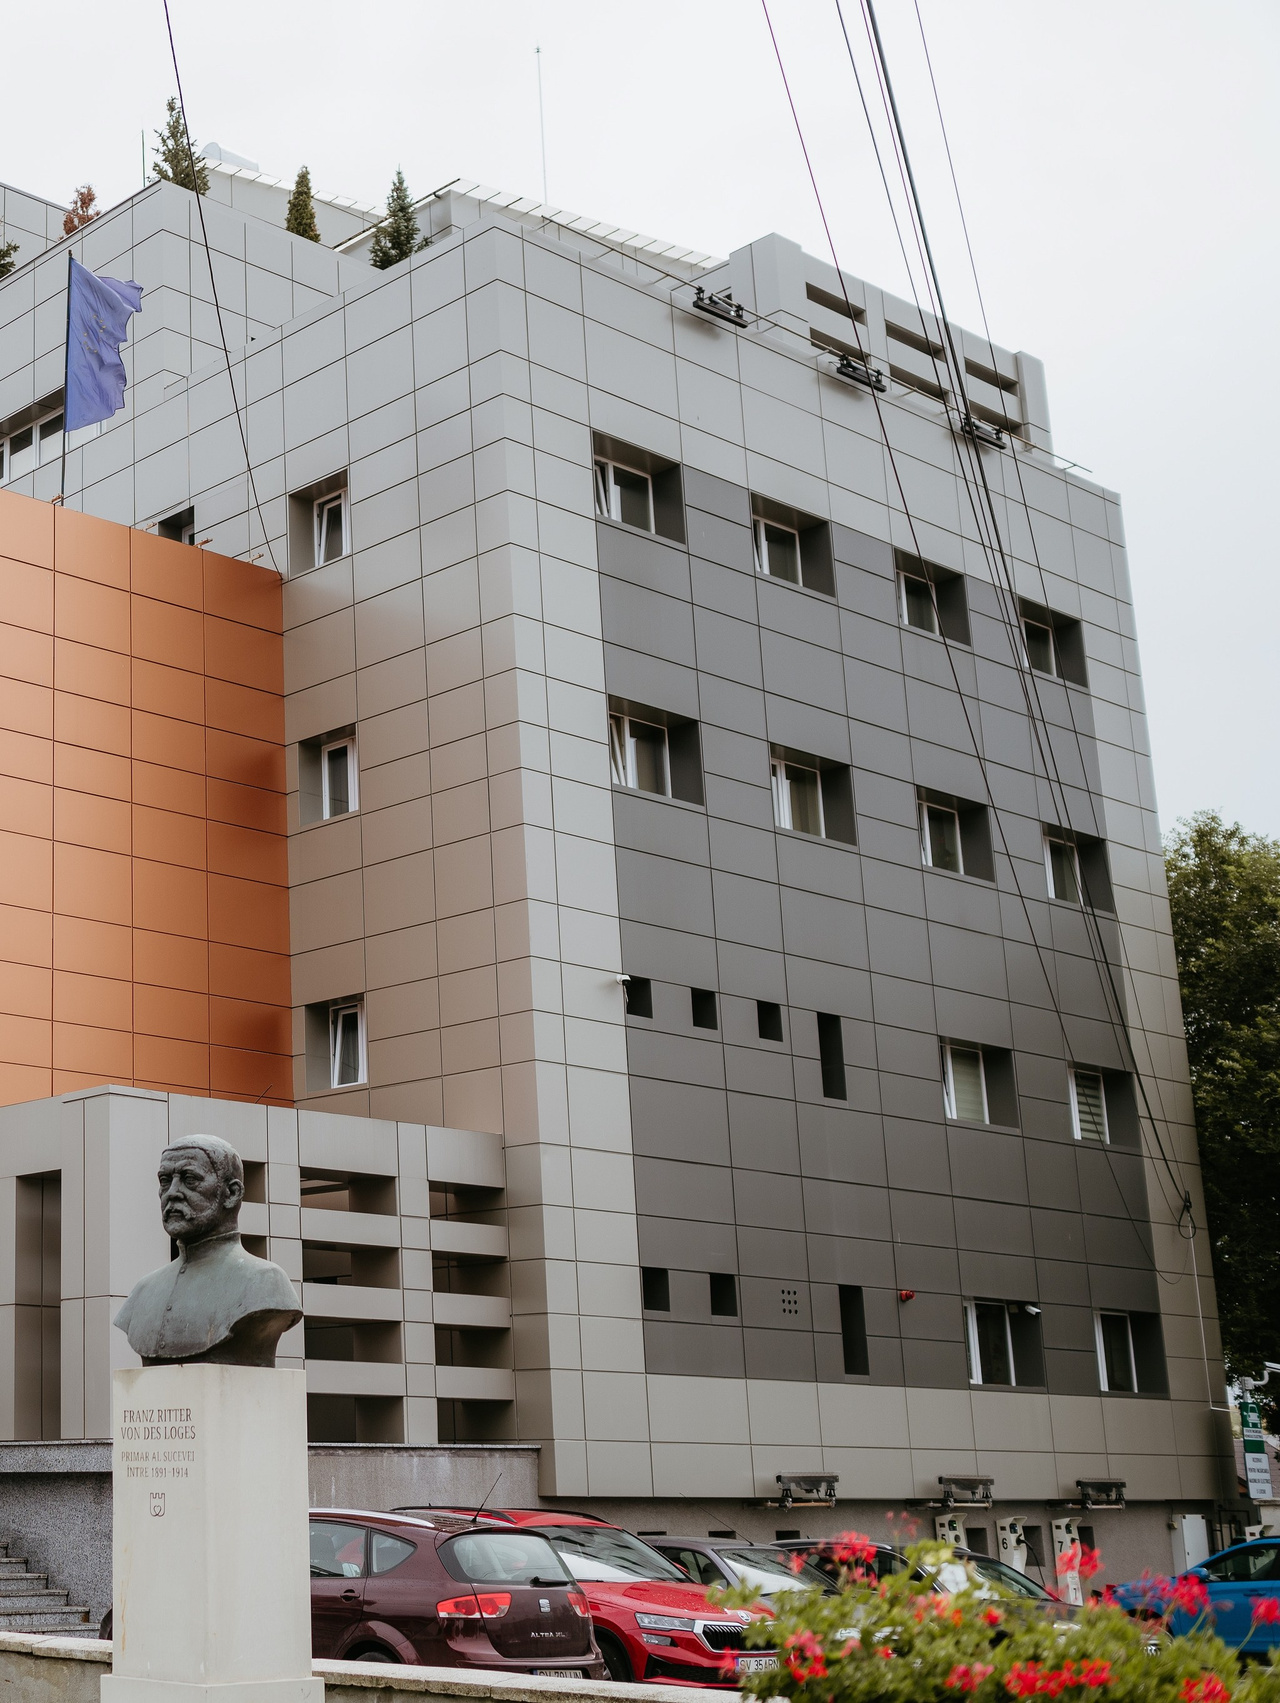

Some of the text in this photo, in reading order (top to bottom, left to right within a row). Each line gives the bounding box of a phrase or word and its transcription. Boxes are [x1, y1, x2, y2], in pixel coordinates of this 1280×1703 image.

[123, 1408, 192, 1423] FRANZ RITTER
[120, 1425, 196, 1440] VON DES LOGES
[121, 1450, 195, 1462] PRIMAR AL SUCEVEI
[127, 1464, 149, 1478] ÎNTRE
[1002, 1538, 1008, 1550] 6
[1058, 1541, 1063, 1553] 7
[740, 1660, 751, 1671] SV
